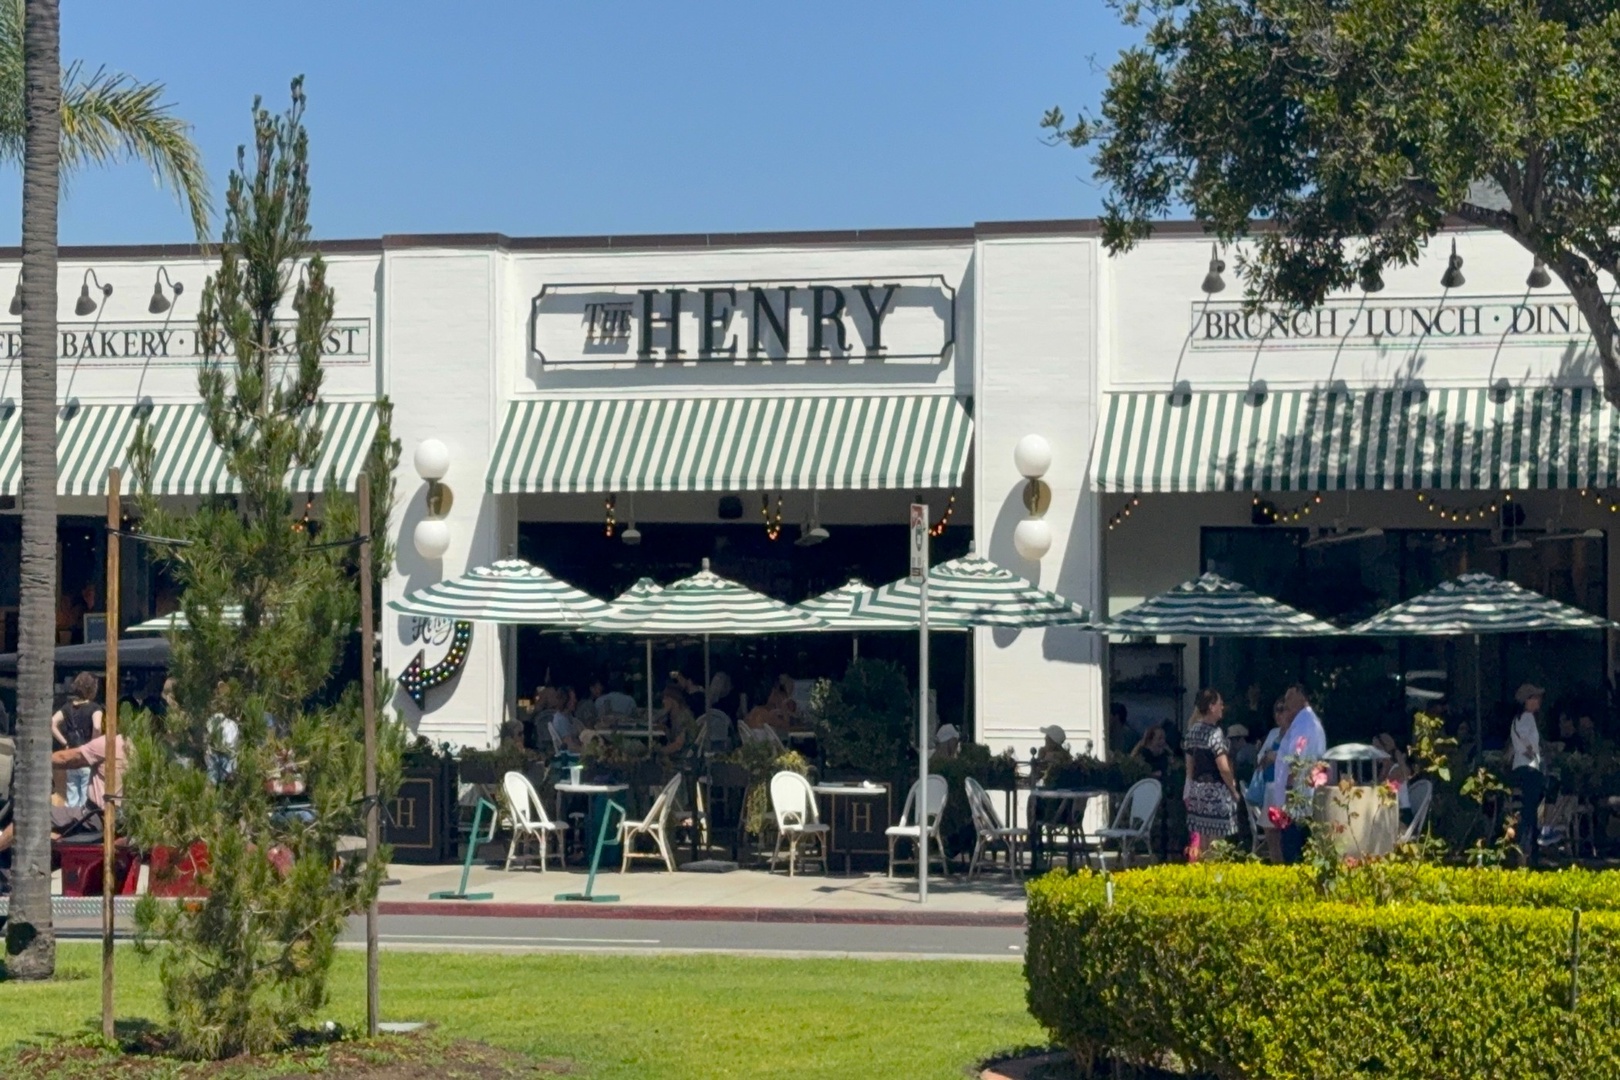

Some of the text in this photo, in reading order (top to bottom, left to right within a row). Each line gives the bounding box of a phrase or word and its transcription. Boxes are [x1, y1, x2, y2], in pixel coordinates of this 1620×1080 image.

[584, 283, 901, 353] THE HENRY
[1205, 303, 1620, 339] BRUNCH LUNCH DIN
[61, 331, 174, 358] BAKERY
[396, 797, 416, 828] H
[850, 802, 873, 833] H
